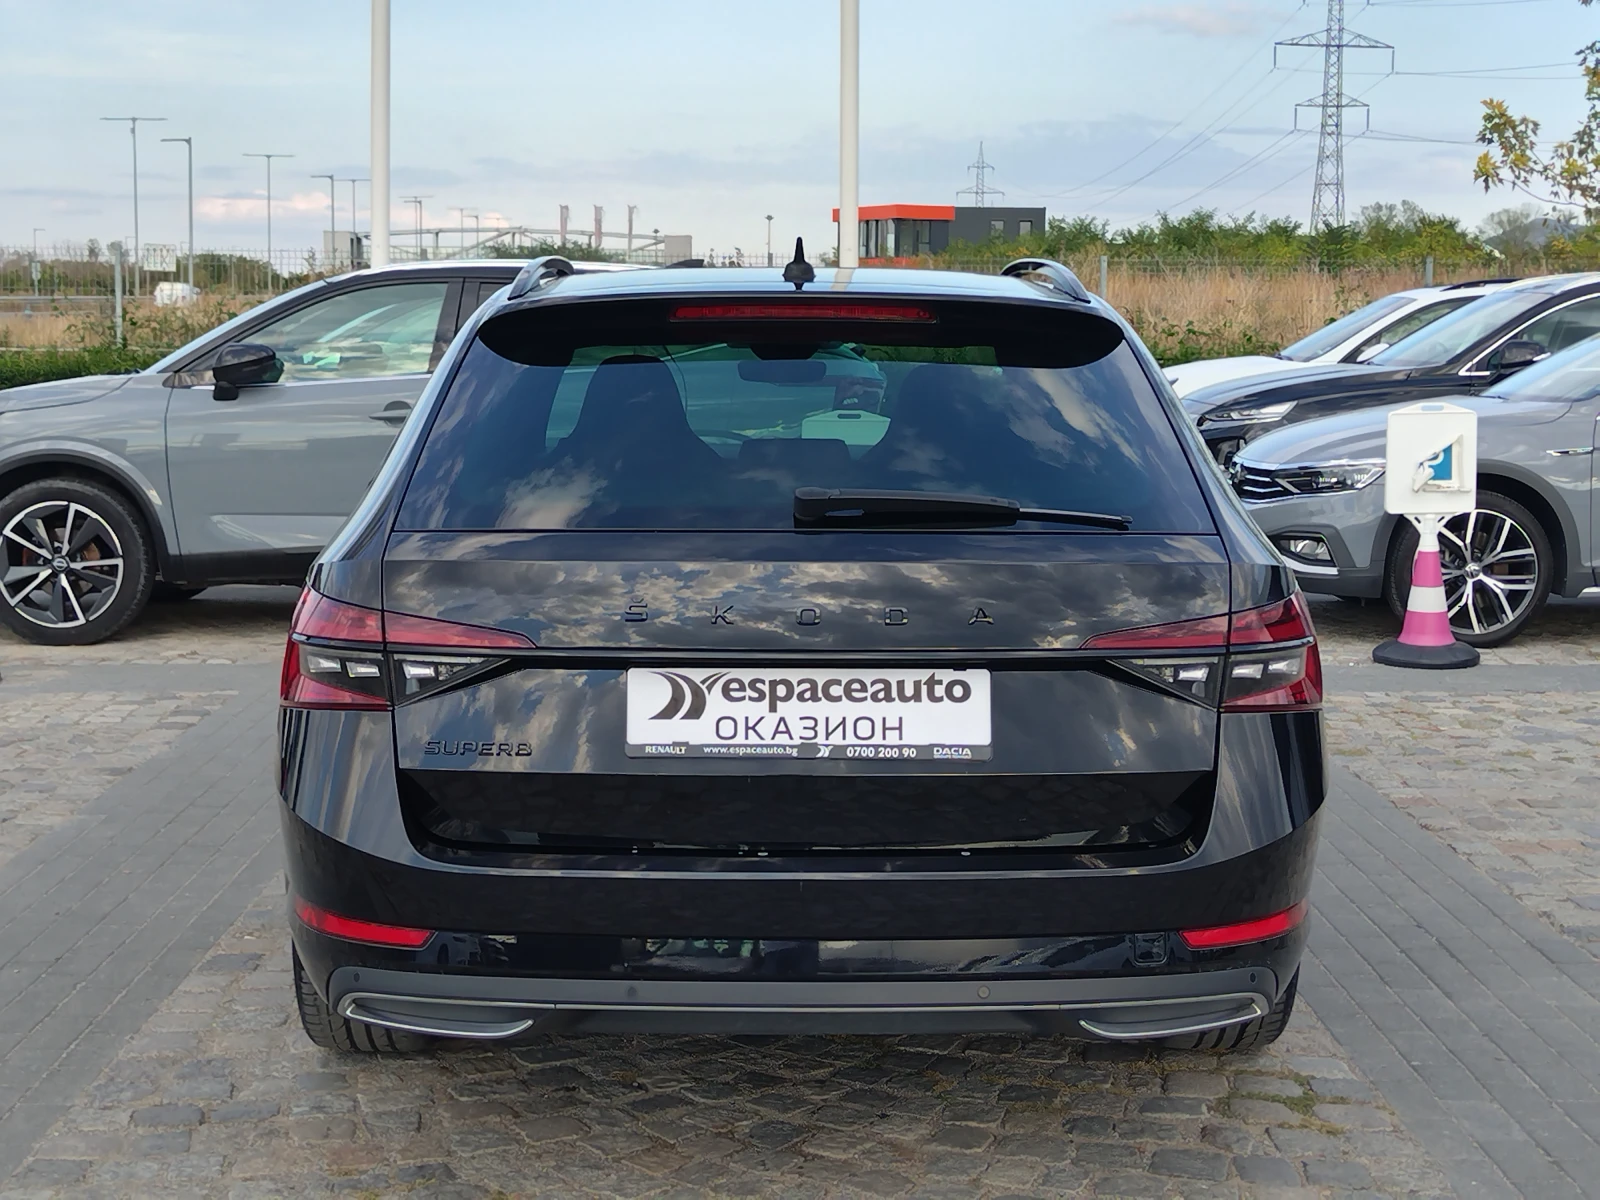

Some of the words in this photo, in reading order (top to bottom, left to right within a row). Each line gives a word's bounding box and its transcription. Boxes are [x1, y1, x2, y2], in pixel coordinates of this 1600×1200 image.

[721, 672, 972, 713] espaceauto
[715, 716, 903, 741] ОКАЗИОН
[424, 740, 533, 757] SUPERB
[644, 745, 687, 755] RENAULT
[702, 746, 799, 757] www.espaceauto.bg
[846, 747, 875, 758] 0700
[877, 747, 900, 758] 200
[901, 747, 917, 758] 90
[933, 747, 972, 755] DACIA
